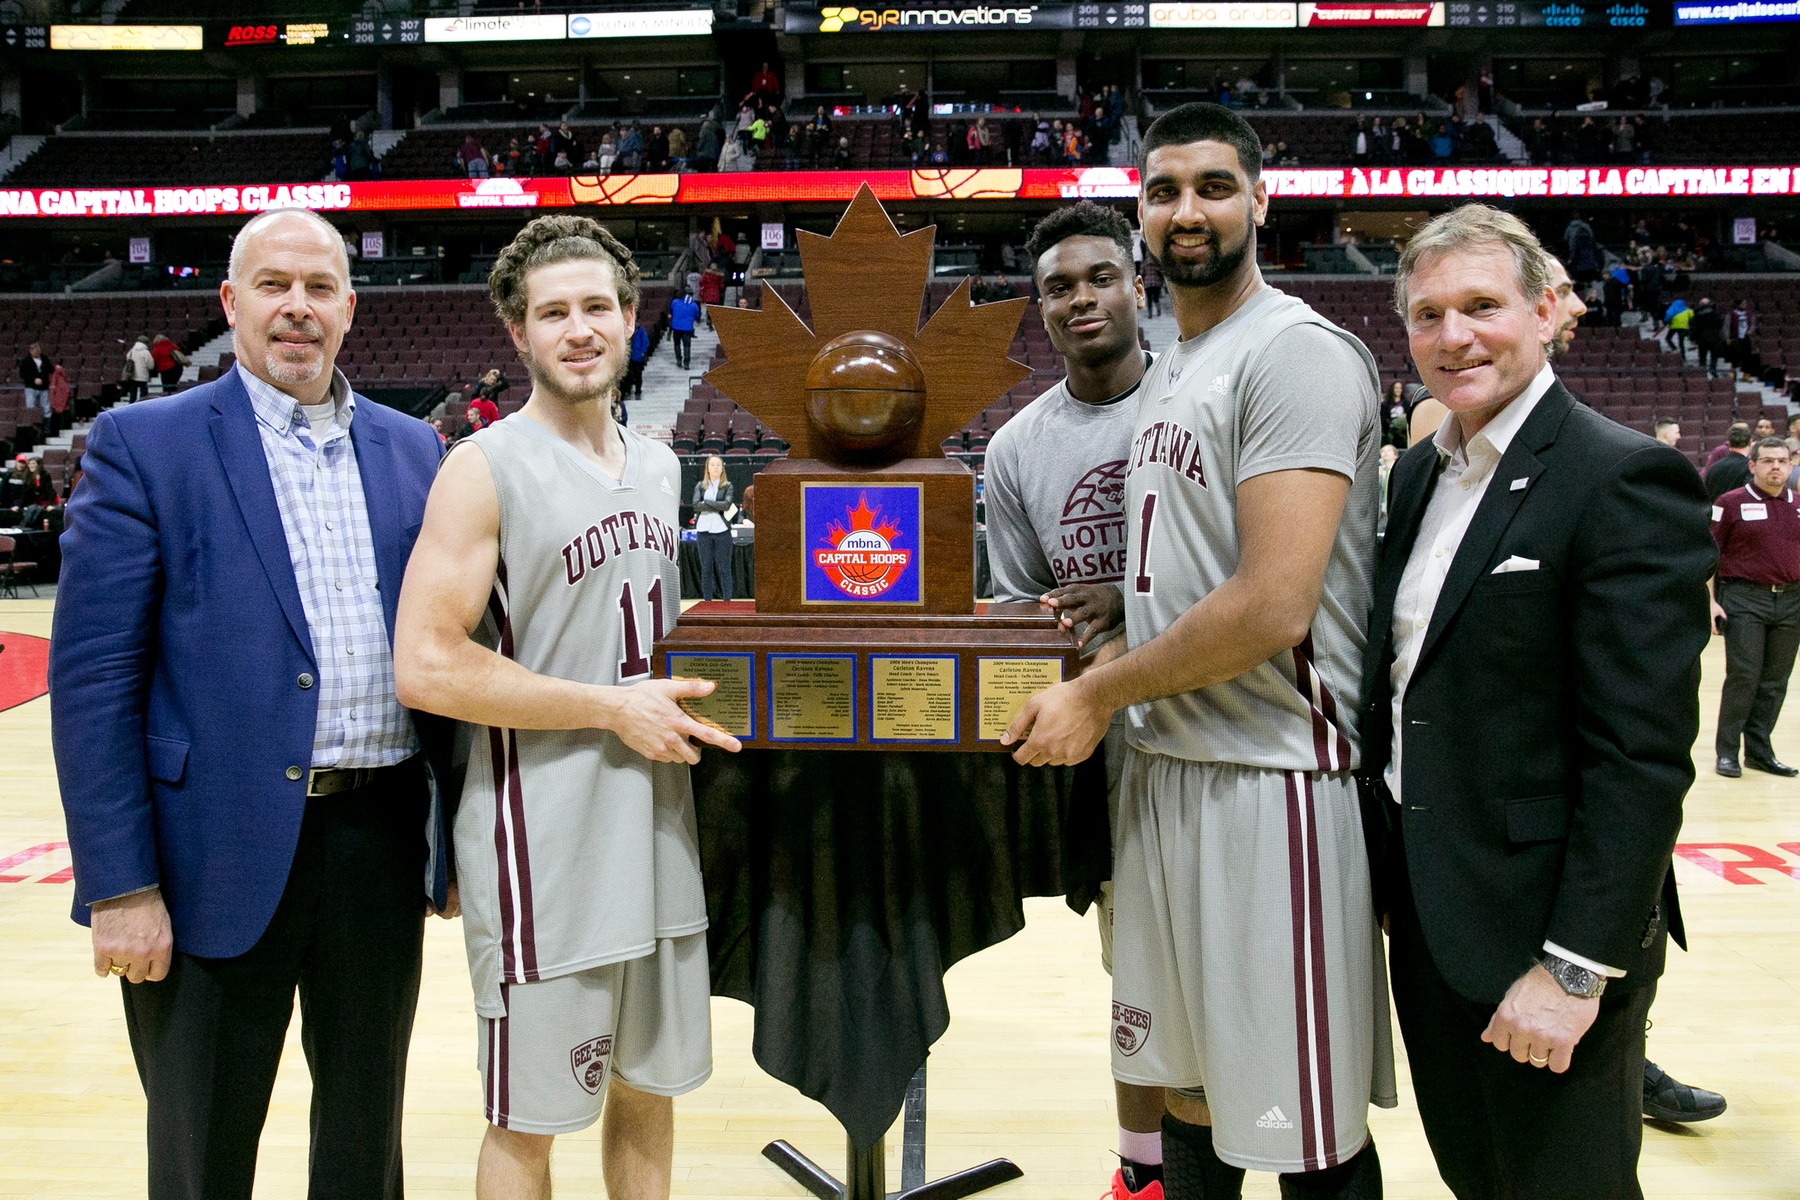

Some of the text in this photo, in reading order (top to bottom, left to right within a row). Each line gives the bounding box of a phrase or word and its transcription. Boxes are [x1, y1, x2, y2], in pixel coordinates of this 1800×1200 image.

[1153, 7, 1292, 21] aruba aruba
[228, 25, 277, 41] ROSS
[1350, 167, 1370, 195] À
[1370, 169, 1403, 195] LA
[1406, 169, 1548, 197] CLASSIQUE
[1550, 169, 1586, 195] DE
[1588, 168, 1623, 195] LA
[1625, 168, 1749, 195] CAPITALE
[1751, 167, 1790, 194] EN
[39, 189, 152, 215] CAPITAL
[153, 187, 240, 214] HOOPS
[241, 184, 351, 211] CLASSIC
[764, 230, 782, 240] 106
[364, 238, 382, 249] 105
[561, 510, 680, 587] UOTTAW
[847, 538, 881, 549] mbna
[1136, 492, 1157, 594] 1
[818, 553, 907, 564] CAPITAL HOOPS
[840, 579, 889, 595] CLASSIC
[1255, 1119, 1294, 1129] adidas
